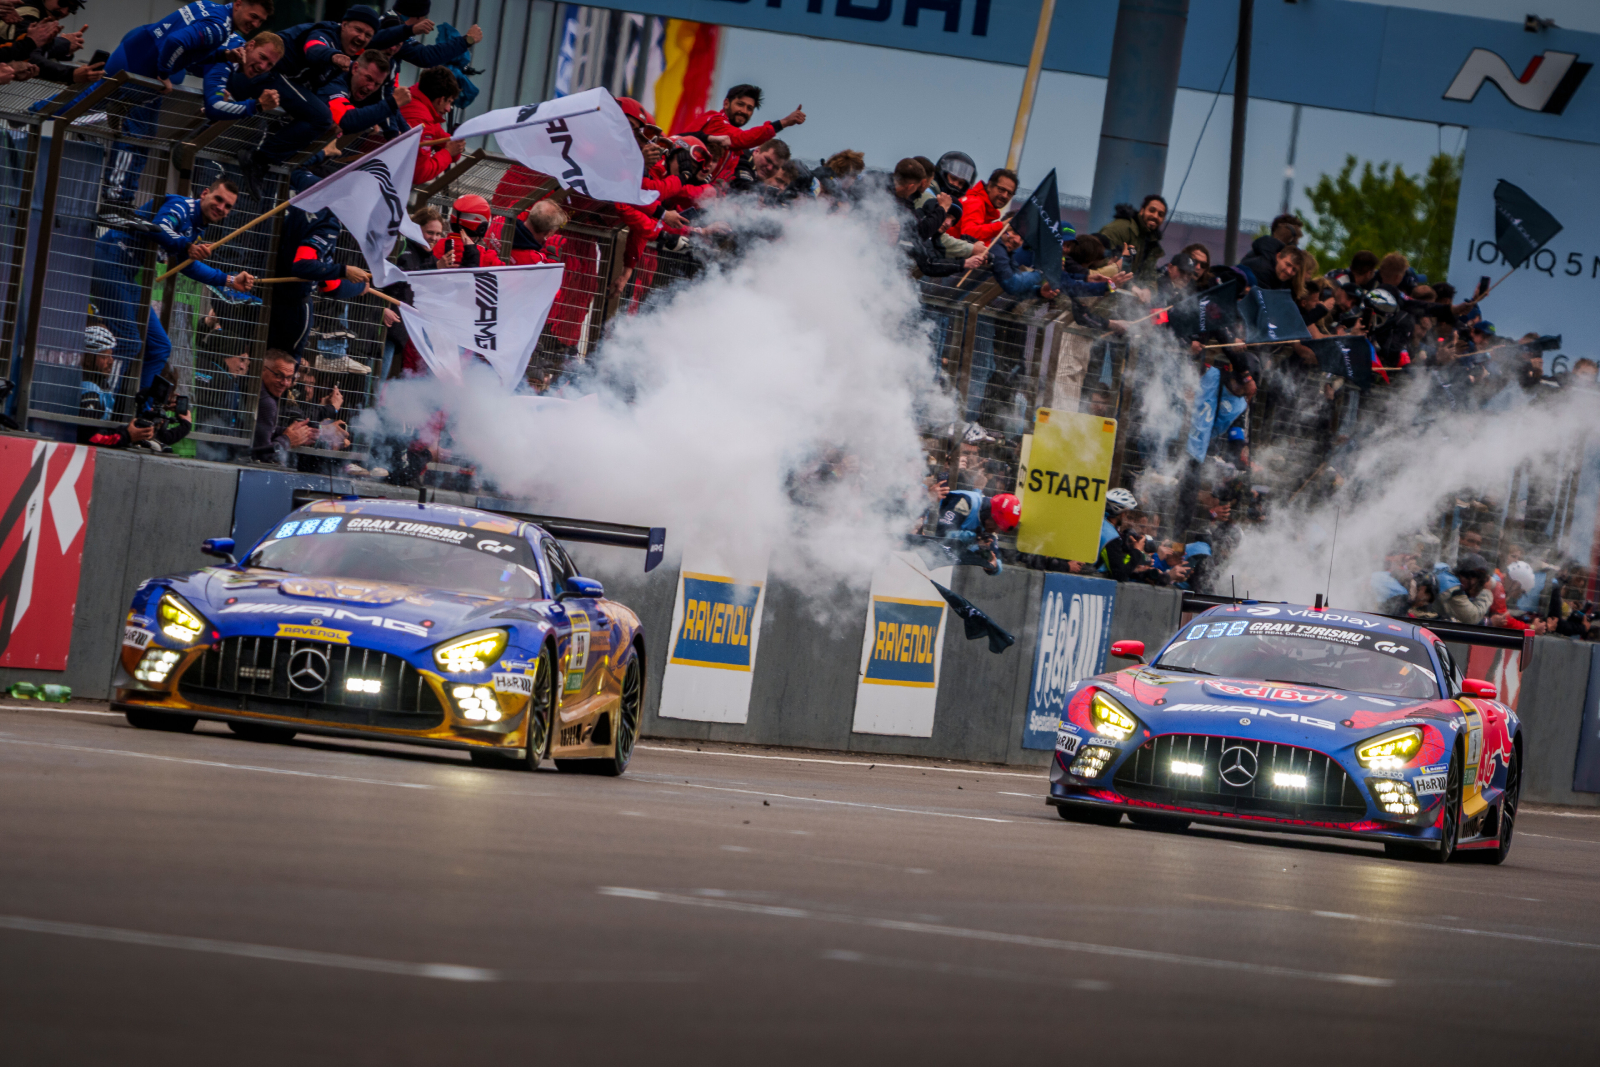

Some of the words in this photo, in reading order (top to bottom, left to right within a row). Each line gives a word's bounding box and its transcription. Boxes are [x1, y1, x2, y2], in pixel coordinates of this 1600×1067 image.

[1467, 238, 1555, 278] IOIQ
[1564, 252, 1583, 277] 5
[474, 296, 498, 352] AMG
[1028, 468, 1107, 502] START
[346, 517, 392, 530] GRAN
[395, 521, 468, 541] TURISMO
[286, 605, 429, 638] AMG
[683, 599, 750, 647] RAVENOL
[1249, 621, 1297, 634] GRAN
[1286, 608, 1381, 629] viaplay
[284, 626, 343, 640] RAVENOL
[875, 621, 935, 664] RAVENOL
[1317, 634, 1359, 646] SIMULATOR
[496, 675, 519, 689] H&R
[1222, 705, 1336, 731] AMG
[1416, 778, 1438, 792] H&R
